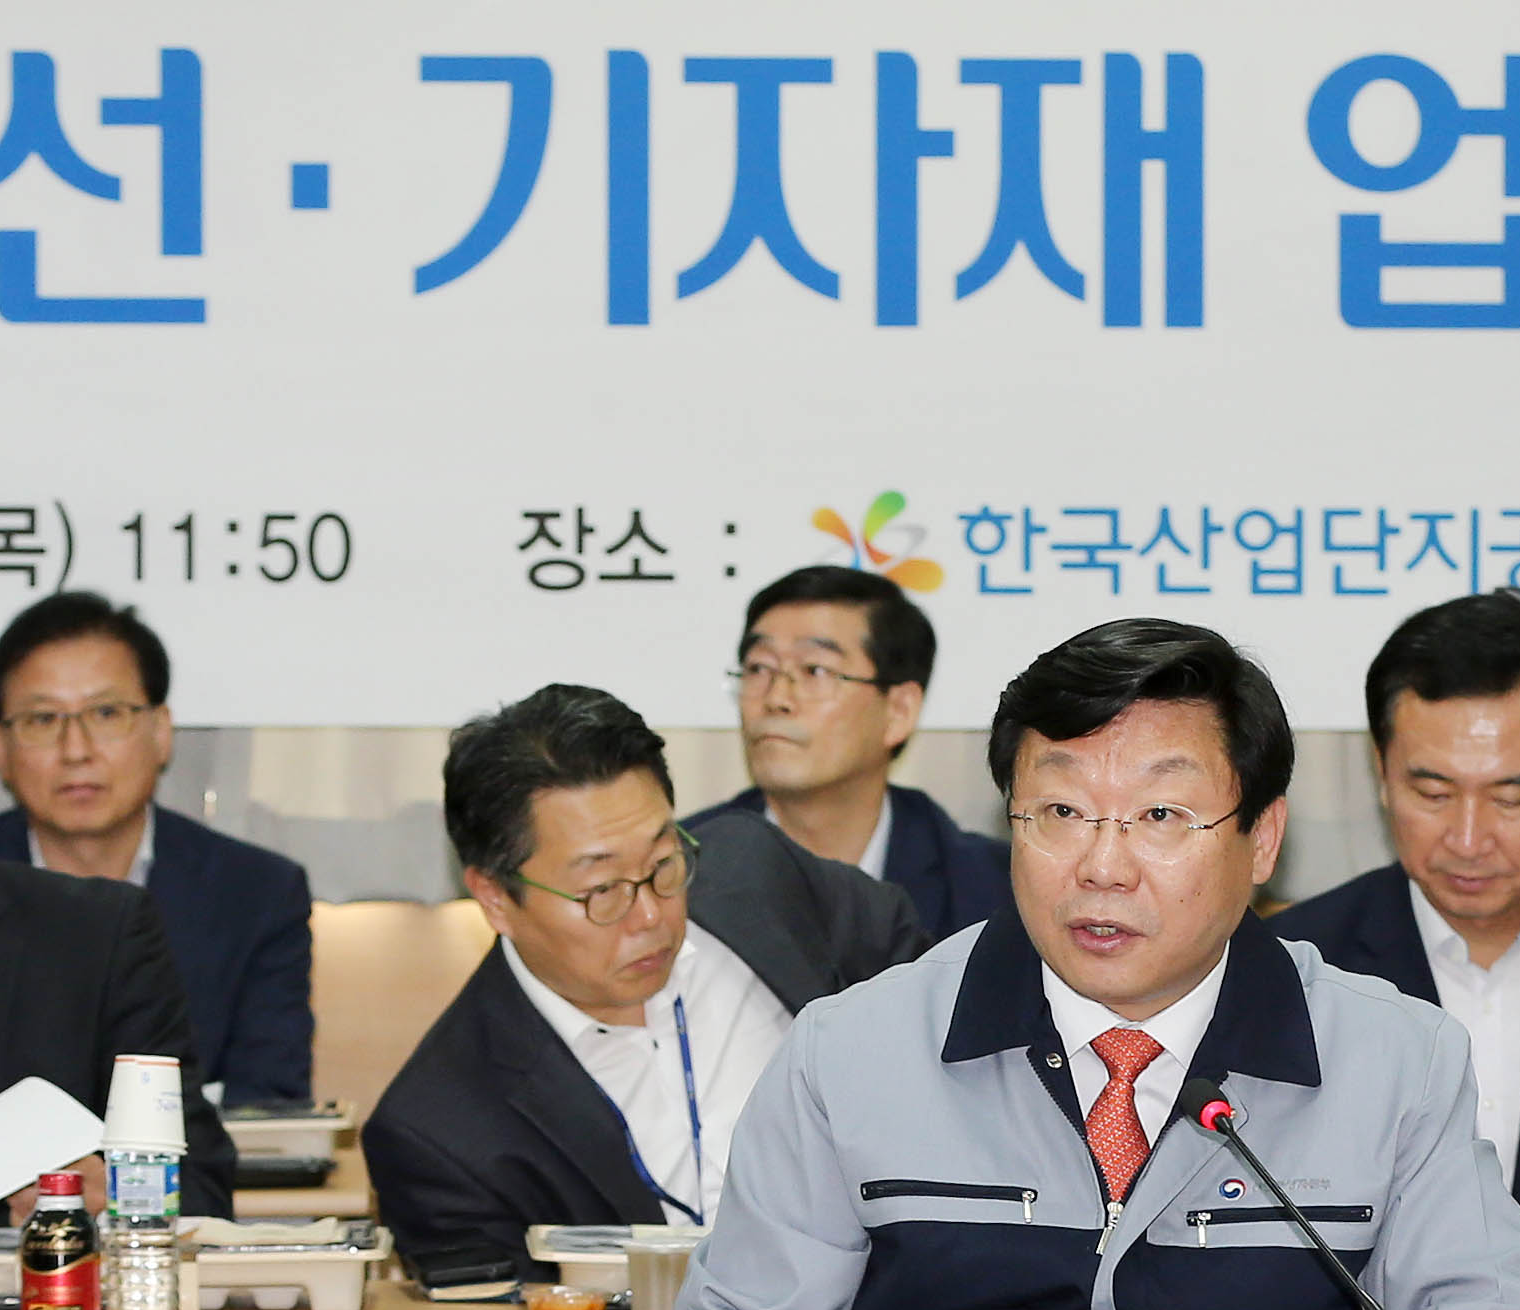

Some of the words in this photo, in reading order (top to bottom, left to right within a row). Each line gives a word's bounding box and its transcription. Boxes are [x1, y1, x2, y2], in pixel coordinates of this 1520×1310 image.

[414, 50, 1205, 328] 기자재
[123, 512, 352, 584] 11:50
[517, 507, 676, 593] 장소
